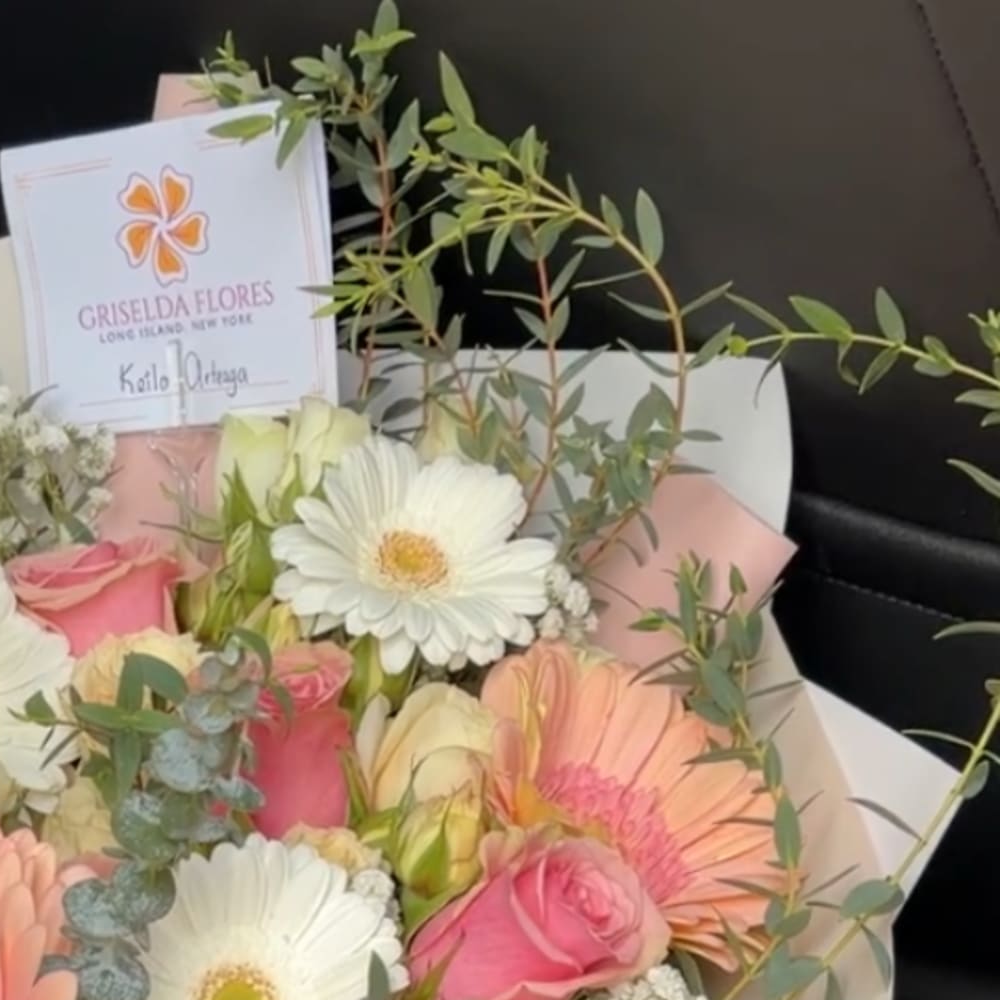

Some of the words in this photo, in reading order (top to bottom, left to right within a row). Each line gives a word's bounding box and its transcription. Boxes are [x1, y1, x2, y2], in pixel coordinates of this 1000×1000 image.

[78, 294, 190, 330] GRISELDA
[194, 280, 275, 314] FLORES
[99, 329, 135, 344] LONG
[191, 318, 217, 331] NEW
[221, 313, 254, 326] YORK
